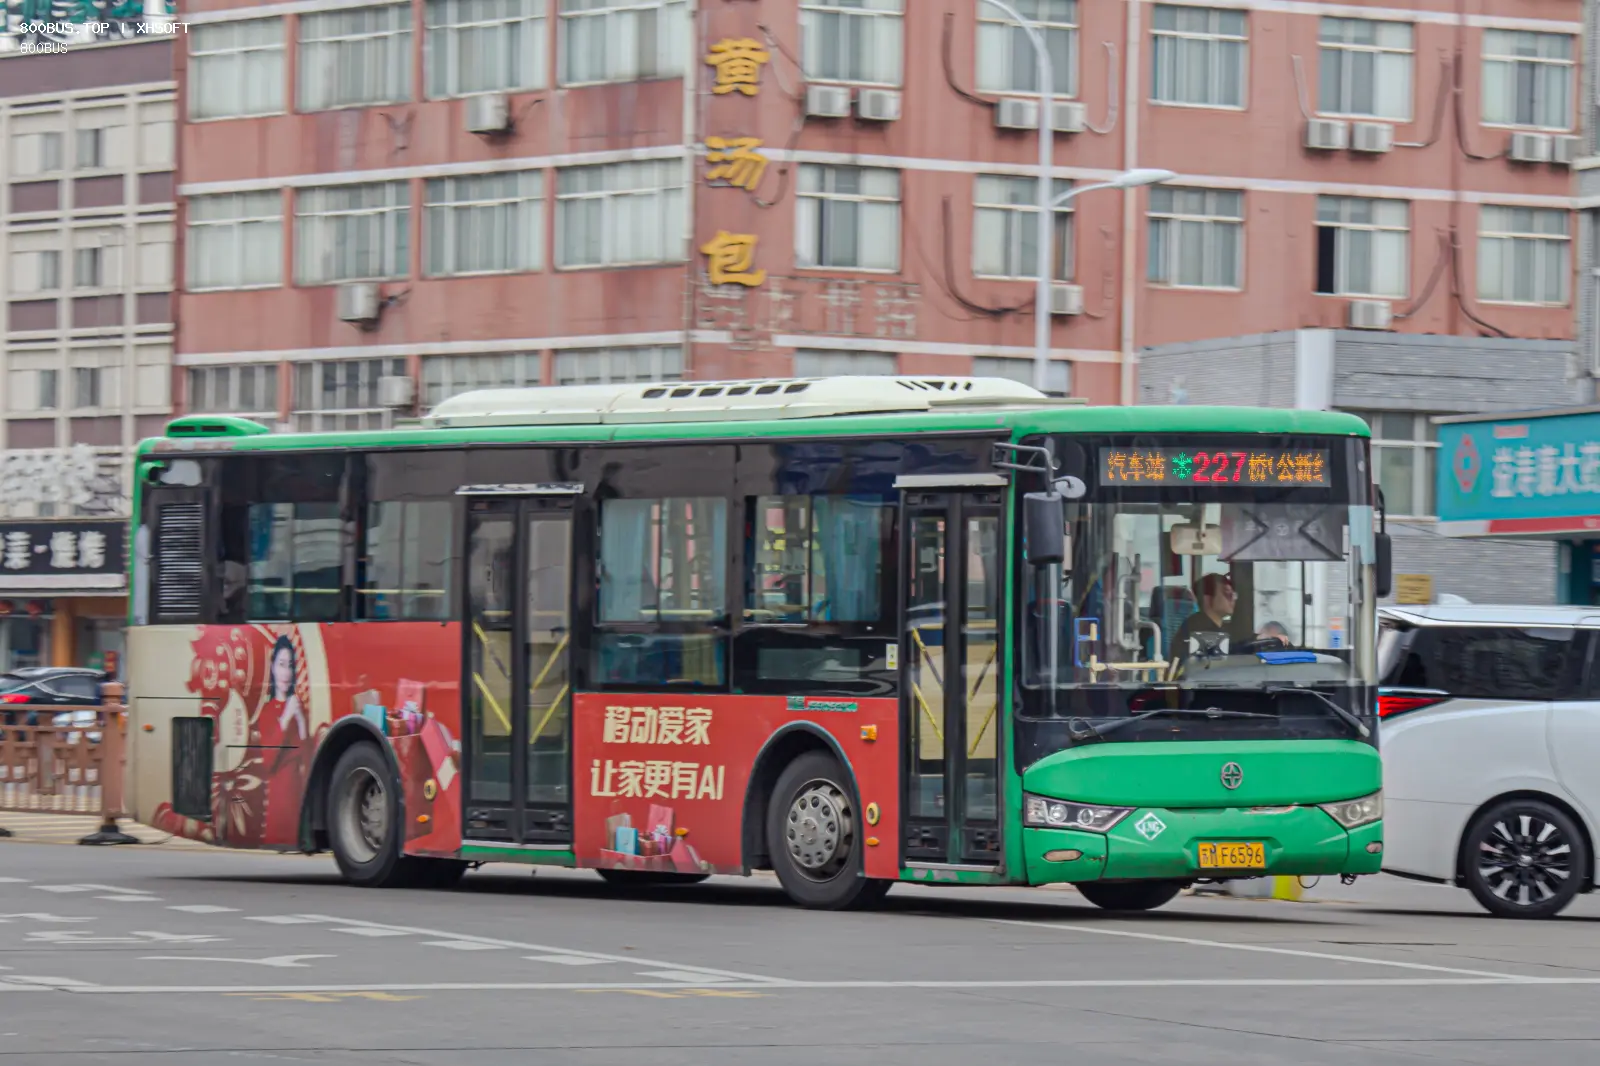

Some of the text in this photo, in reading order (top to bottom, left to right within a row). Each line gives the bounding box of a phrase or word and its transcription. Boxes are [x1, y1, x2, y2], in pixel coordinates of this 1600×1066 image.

[701, 37, 771, 288] 黄汤包
[1107, 451, 1166, 481] 汽车站
[1192, 451, 1247, 482] 227
[602, 705, 713, 745] 移动爱家
[590, 758, 726, 800] 让家更有AI
[1221, 846, 1263, 865] F6596
